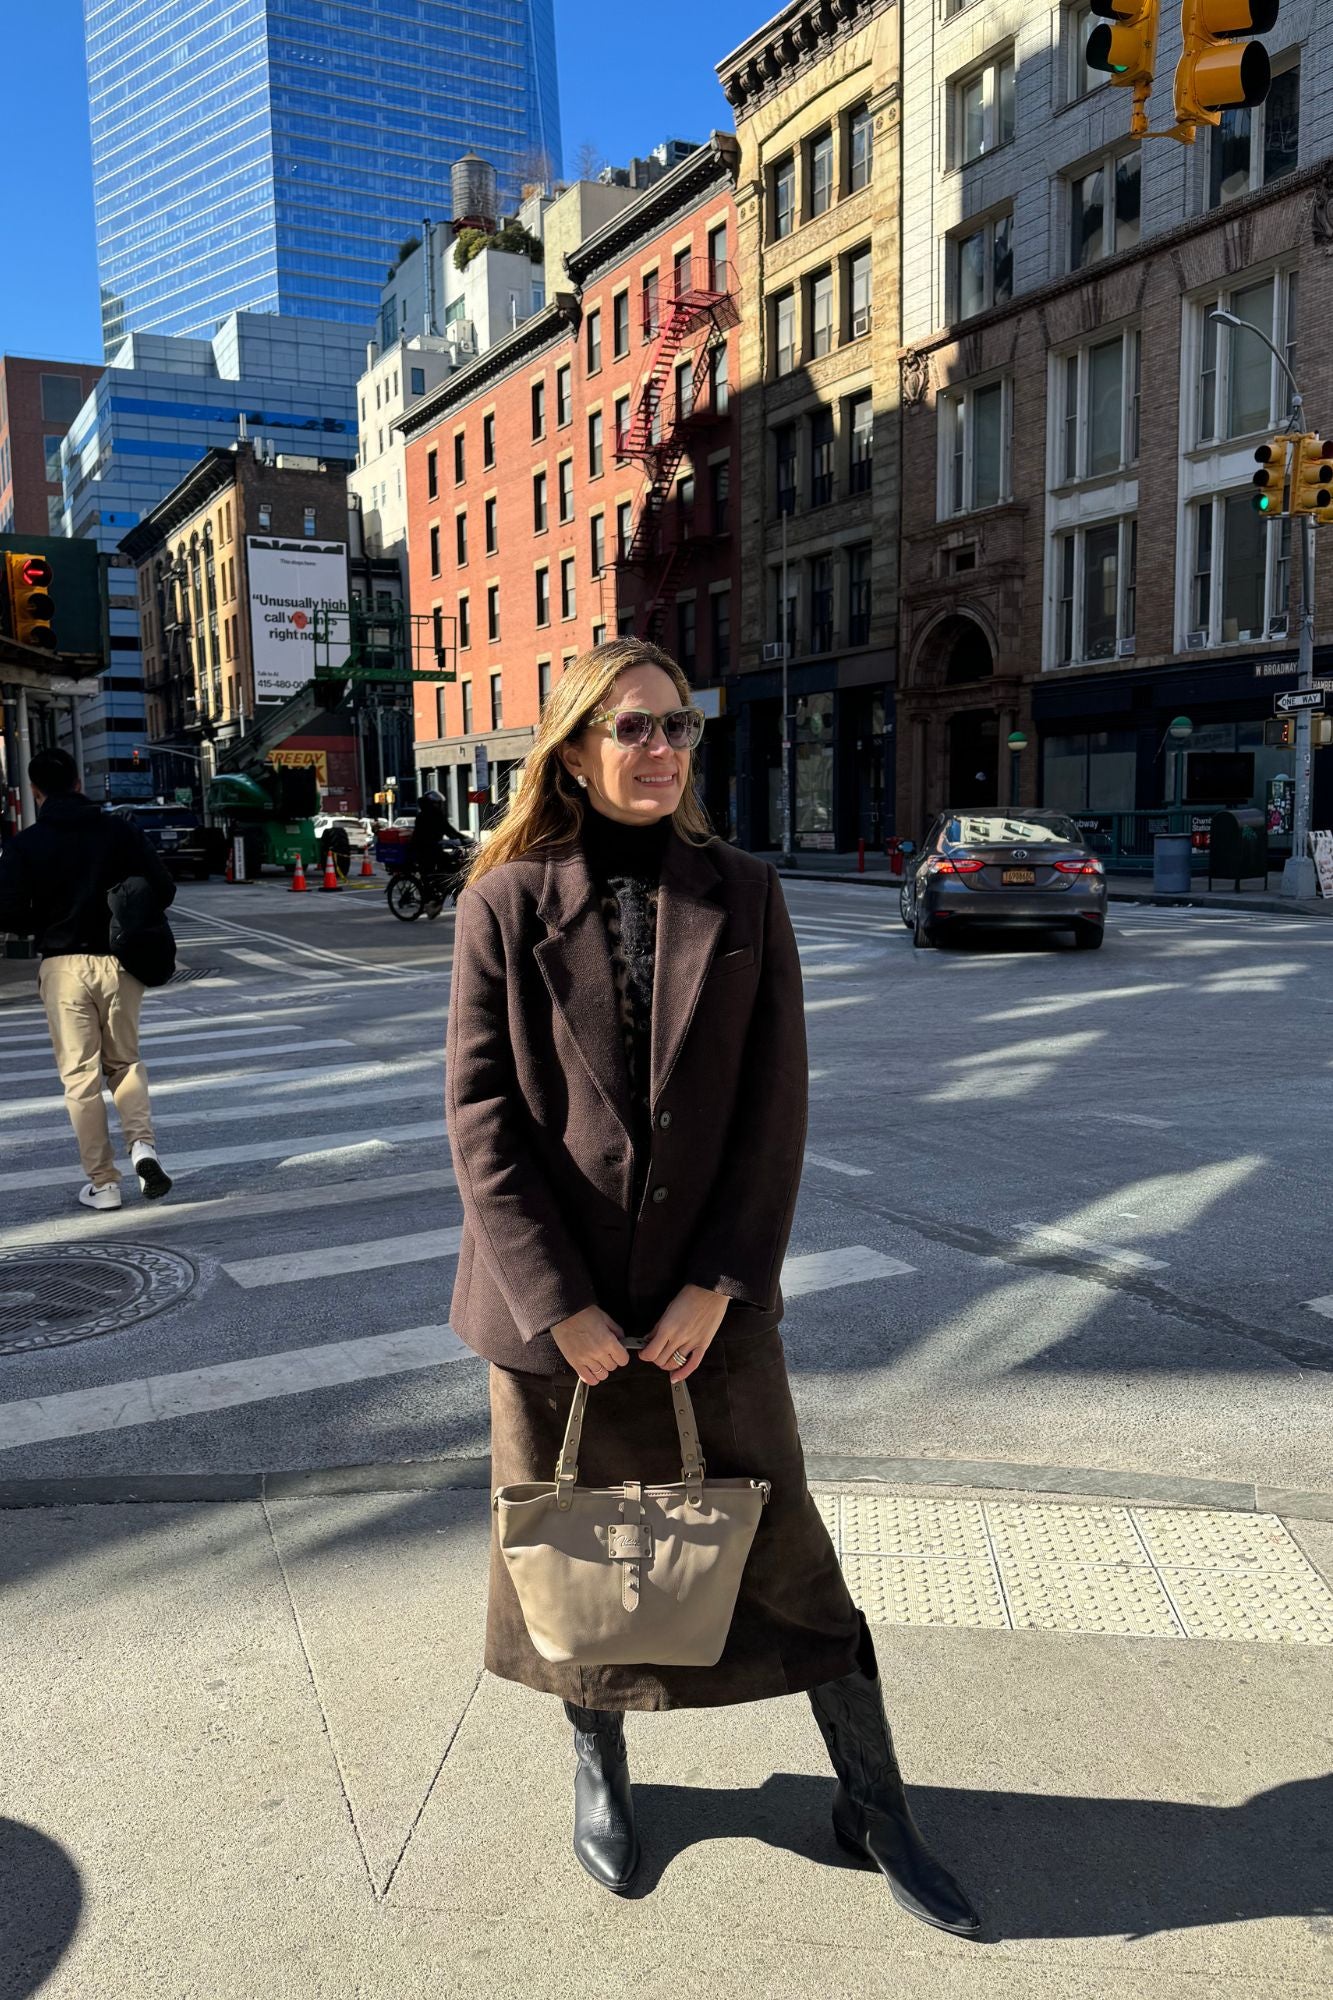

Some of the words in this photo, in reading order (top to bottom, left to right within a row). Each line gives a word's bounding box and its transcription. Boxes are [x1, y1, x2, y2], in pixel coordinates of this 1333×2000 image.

[321, 596, 347, 611] high
[264, 611, 285, 623] call
[269, 629, 299, 643] right
[1255, 665, 1262, 677] W
[1263, 662, 1297, 676] BROADWAY
[1281, 697, 1297, 706] ONE
[1302, 694, 1318, 703] WAY
[1074, 818, 1099, 830] ubway
